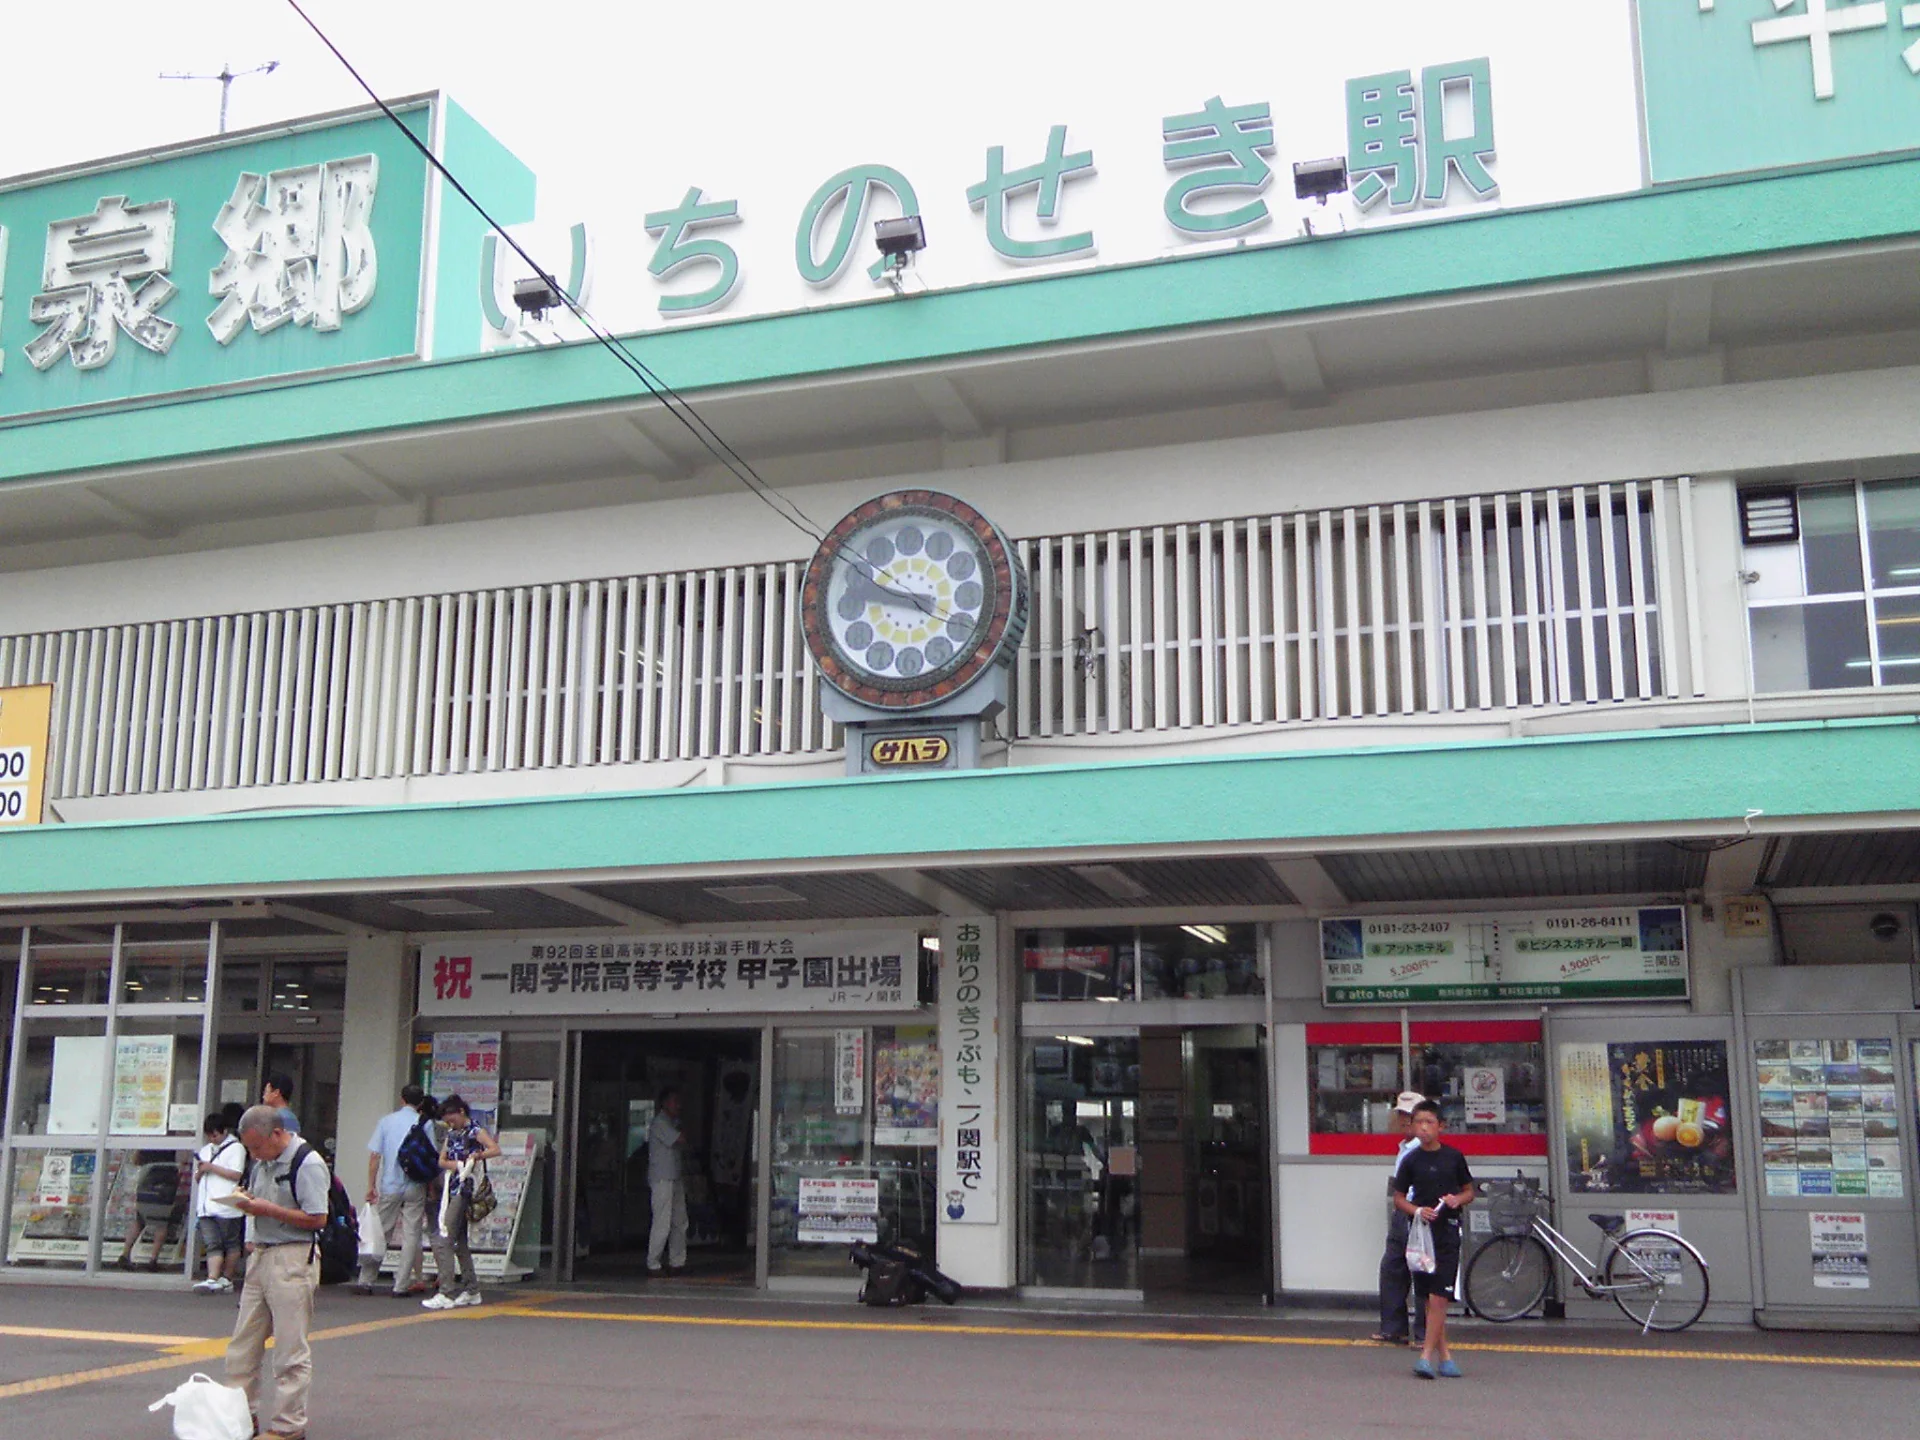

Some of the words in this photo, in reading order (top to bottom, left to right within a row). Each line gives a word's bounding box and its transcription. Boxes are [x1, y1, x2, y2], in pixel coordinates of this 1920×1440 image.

[480, 57, 1498, 332] いちのせき駅
[0, 153, 378, 371] 泉郷
[878, 739, 941, 762] サハラ
[1368, 921, 1450, 935] 0191-23-2407
[1546, 916, 1631, 929] 0191-26-6411
[531, 938, 795, 959] 第92回全国高等学校野球選手権大会
[1385, 943, 1446, 954] アットホテル
[1530, 936, 1633, 951] ビジネスホテル一関
[434, 955, 473, 1000] 祝
[481, 958, 728, 994] 一関学院高等学校
[737, 955, 901, 990] 甲子園出場
[1378, 987, 1409, 998] hotel
